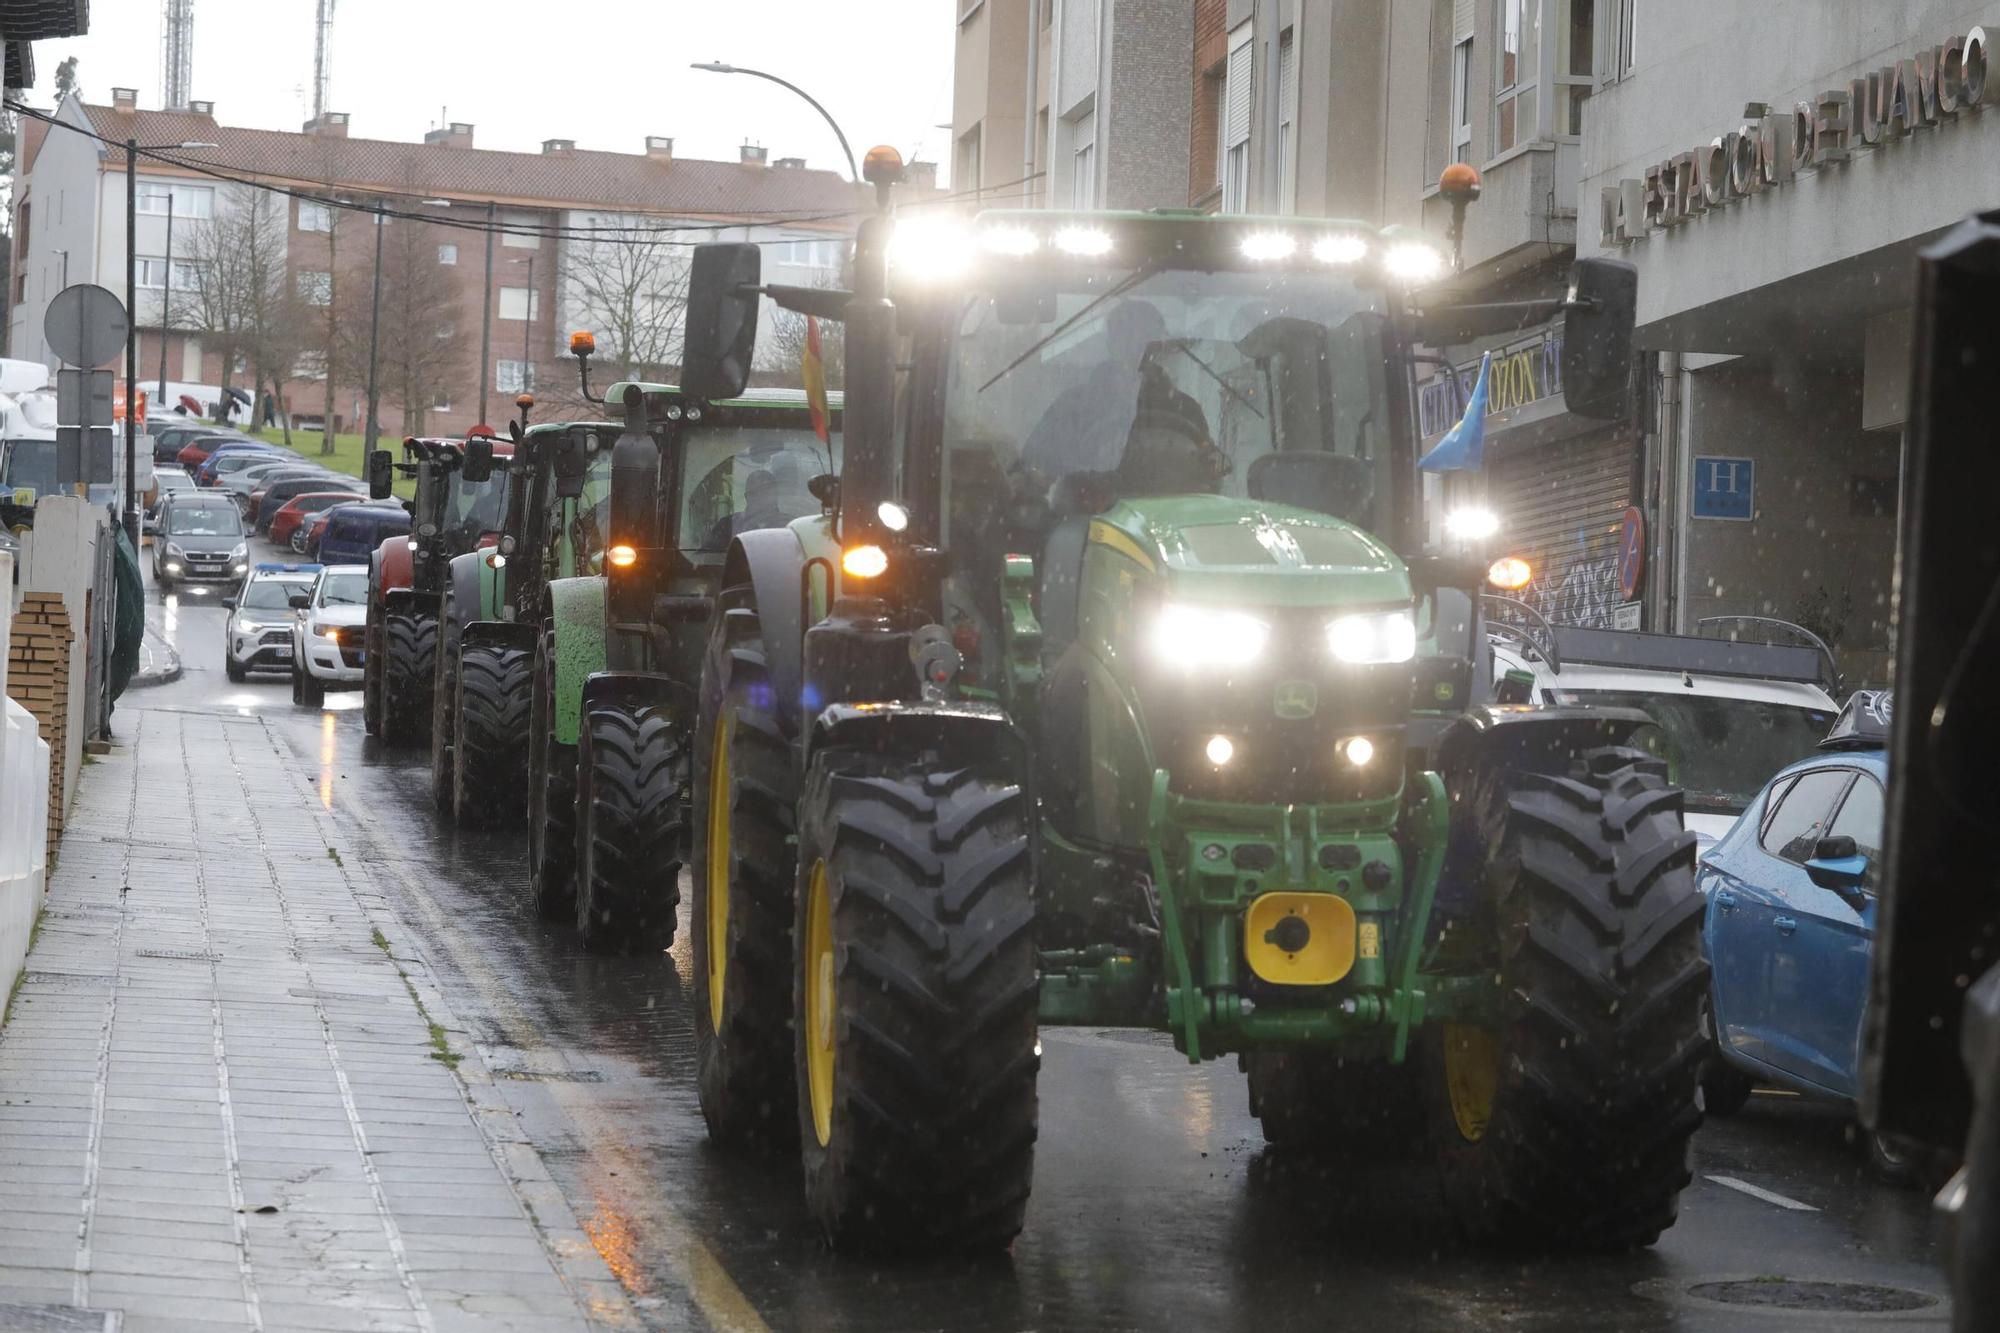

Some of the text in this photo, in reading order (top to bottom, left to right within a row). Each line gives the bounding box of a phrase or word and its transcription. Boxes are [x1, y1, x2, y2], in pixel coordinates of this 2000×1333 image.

[1792, 90, 1852, 174] DE
[1847, 25, 1989, 151] LUANCO
[1706, 462, 1741, 495] H
